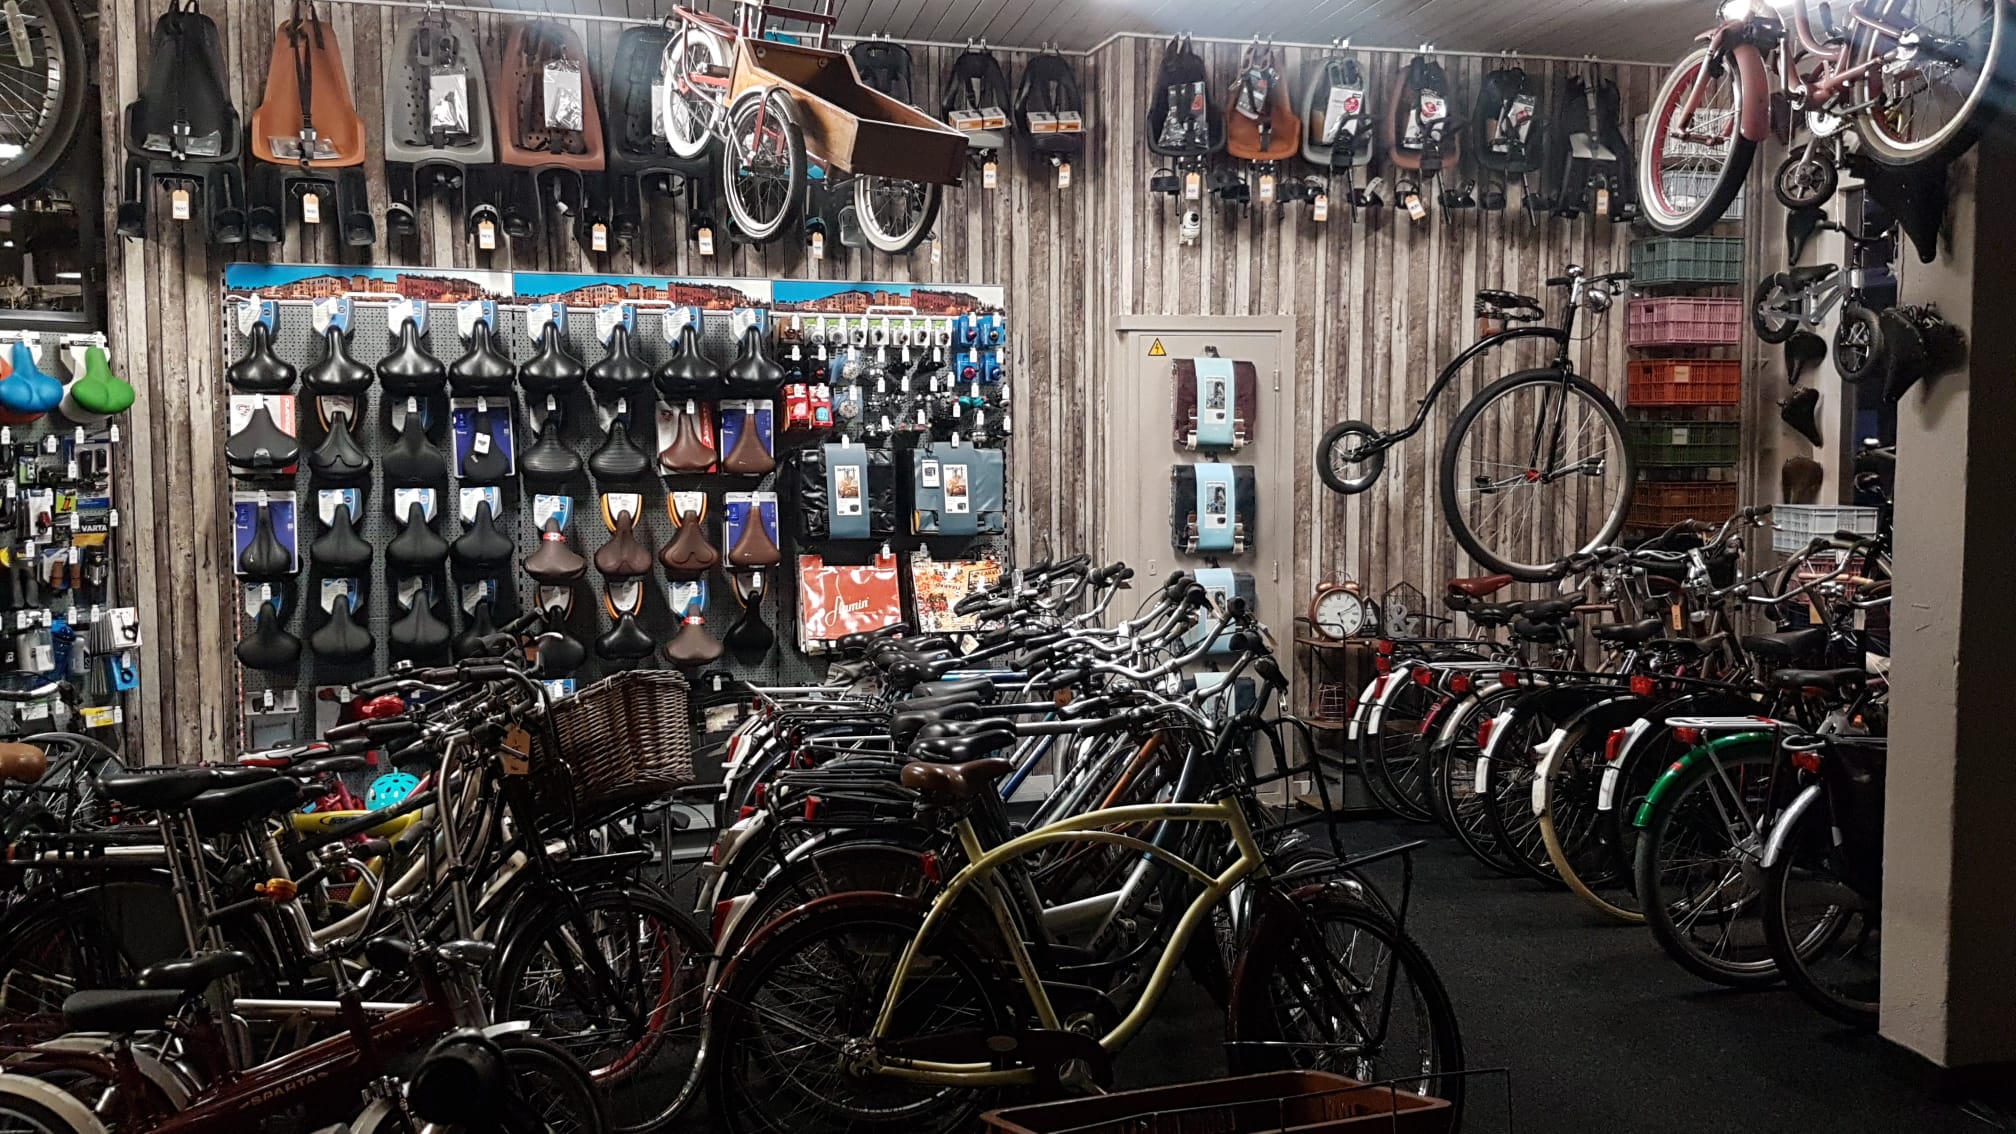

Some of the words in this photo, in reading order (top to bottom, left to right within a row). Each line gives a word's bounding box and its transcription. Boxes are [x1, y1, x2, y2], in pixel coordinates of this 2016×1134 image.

[81, 524, 108, 532] VARTA
[1387, 602, 1420, 638] &
[251, 1074, 318, 1106] SPARTA
